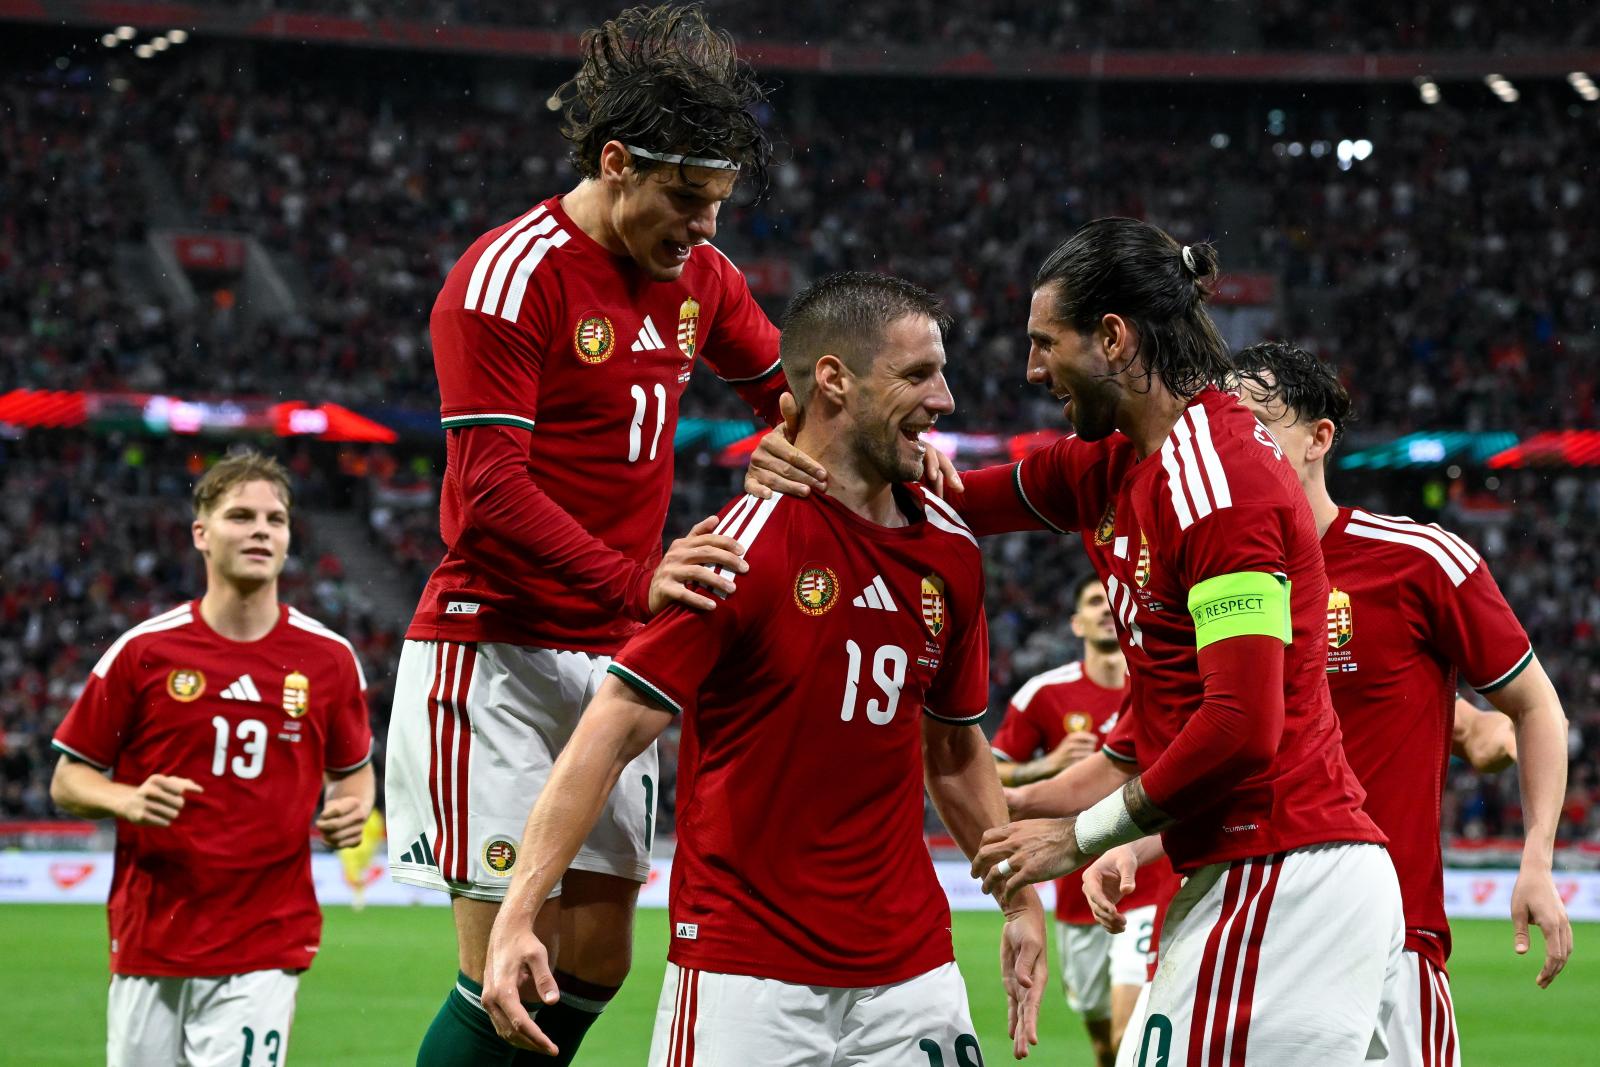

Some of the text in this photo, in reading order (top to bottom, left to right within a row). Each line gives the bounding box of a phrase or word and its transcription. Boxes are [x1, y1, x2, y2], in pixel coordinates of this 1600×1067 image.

[628, 383, 666, 462] 11
[1253, 416, 1284, 461] S
[1205, 598, 1264, 618] RESPECT
[840, 639, 908, 725] 19
[211, 715, 268, 779] 13
